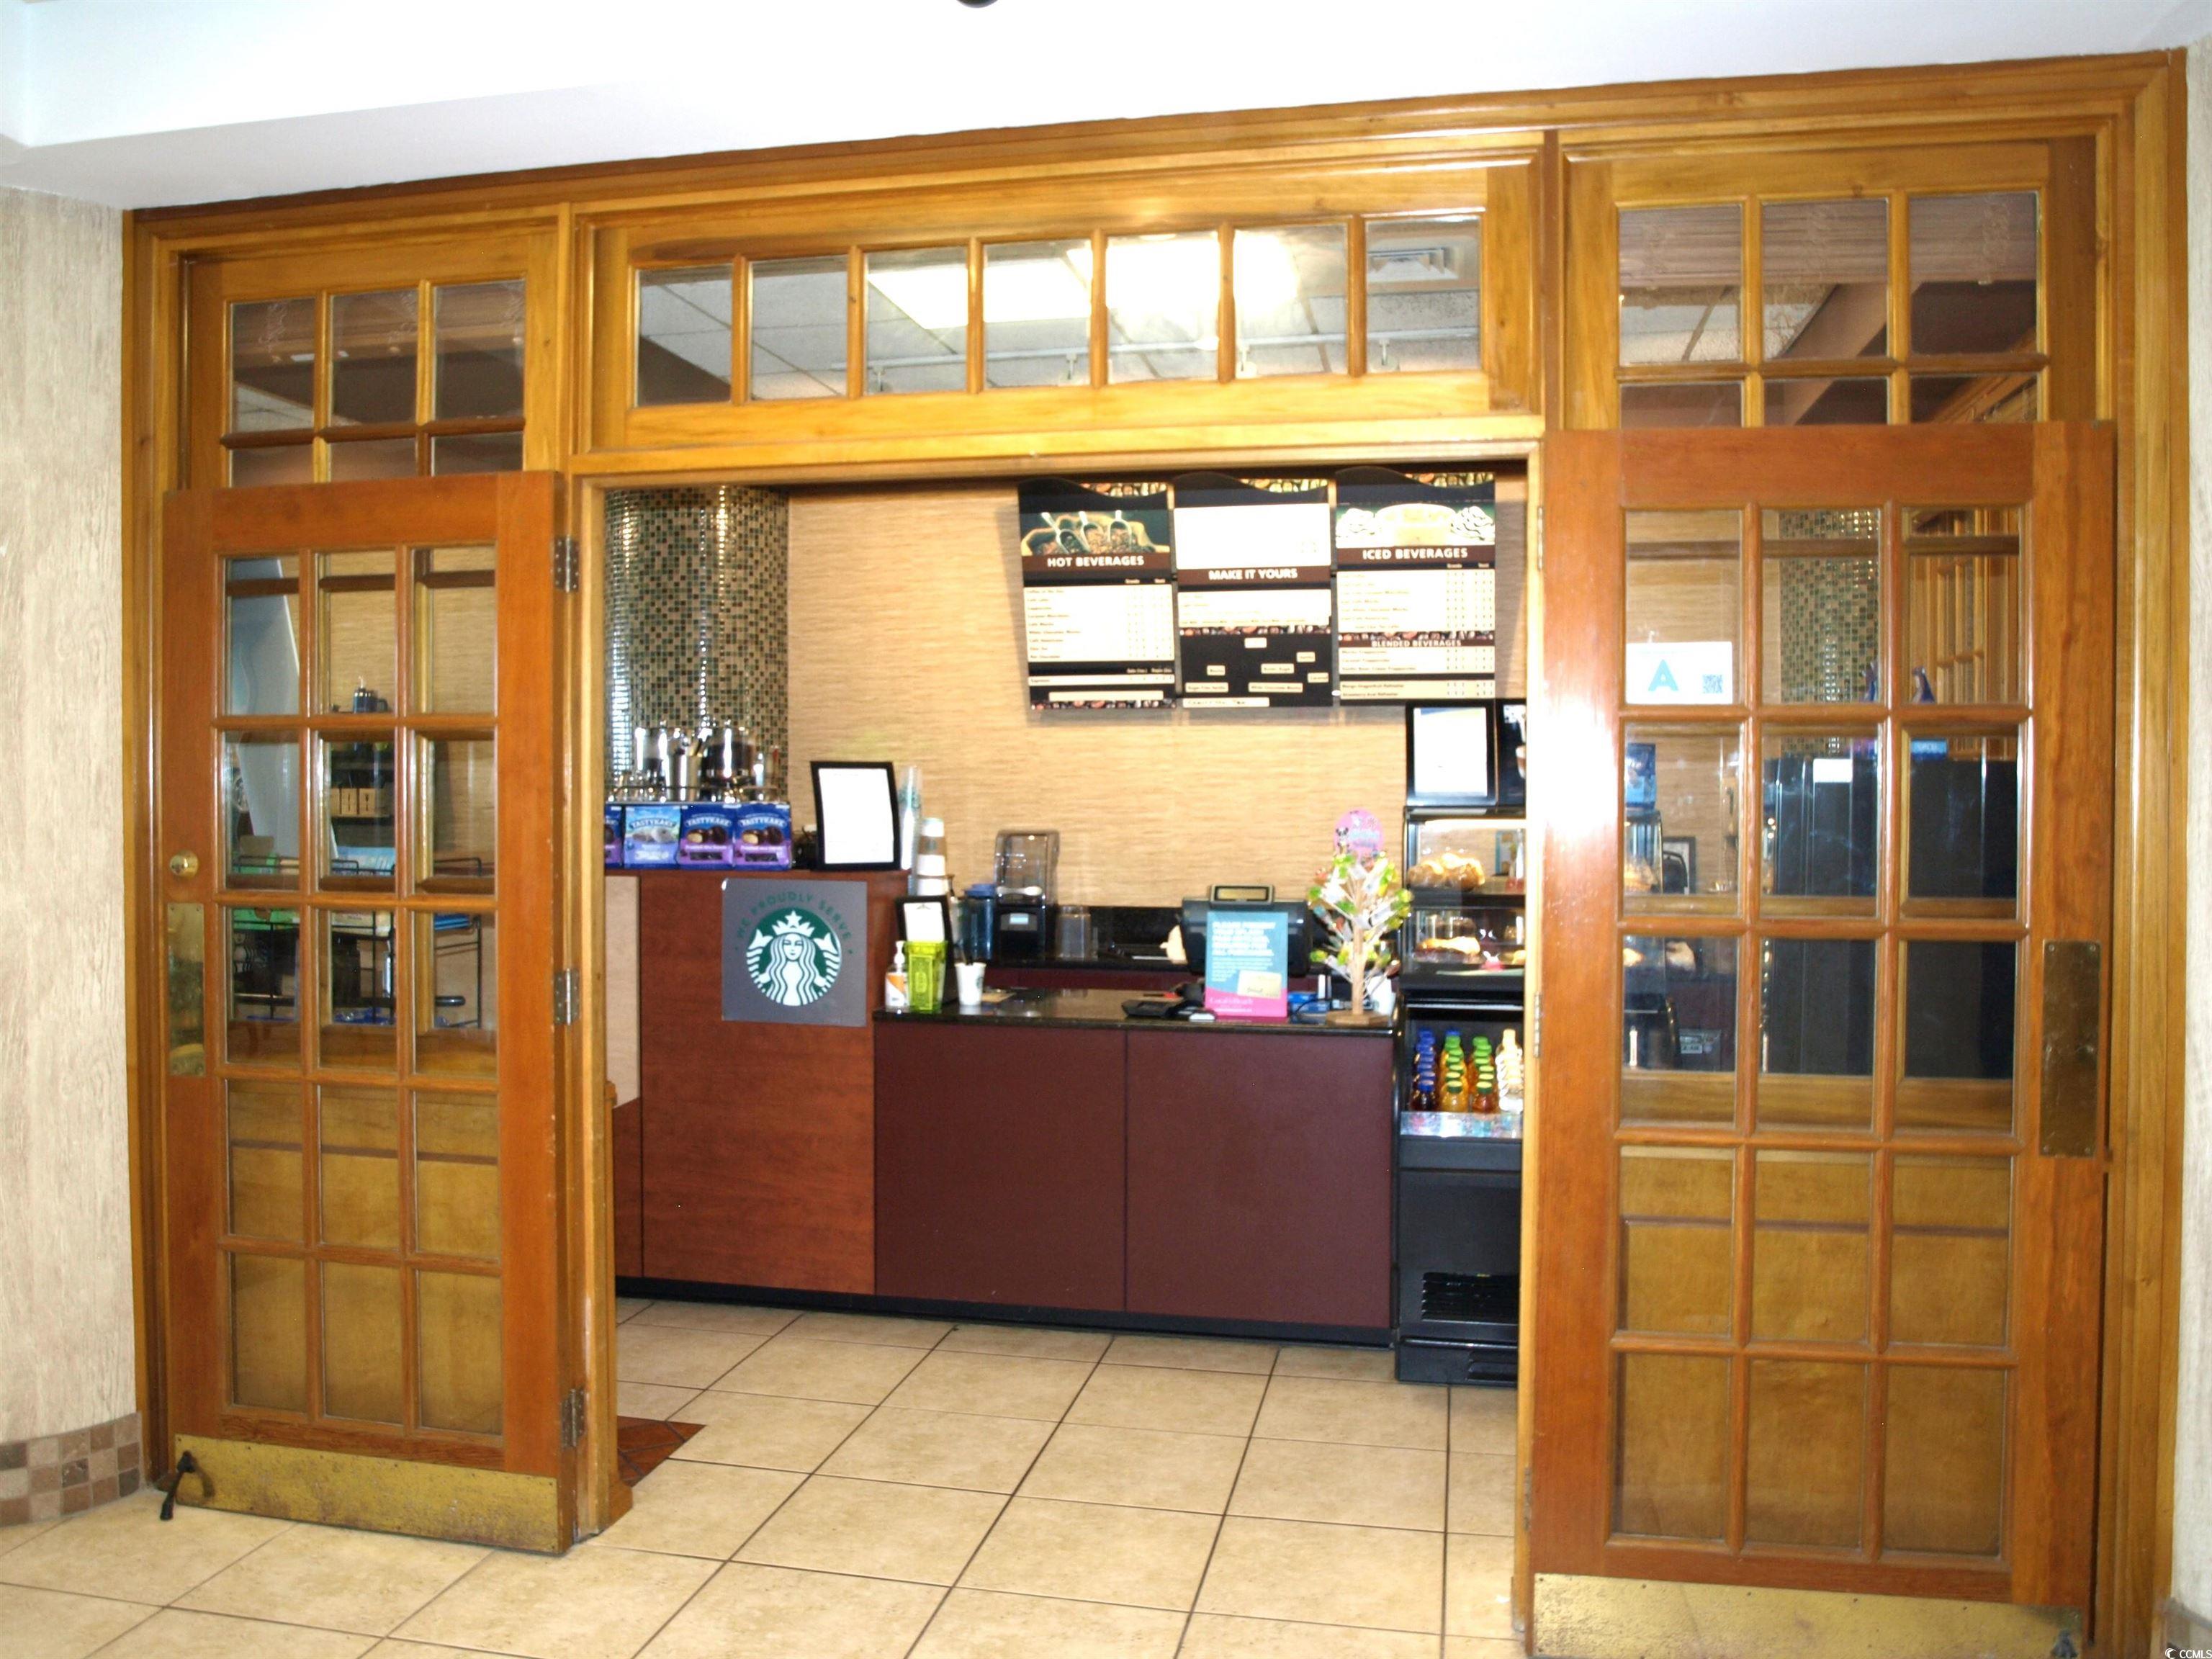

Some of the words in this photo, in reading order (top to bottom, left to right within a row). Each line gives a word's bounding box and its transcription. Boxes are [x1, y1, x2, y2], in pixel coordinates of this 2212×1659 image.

[1362, 549, 1392, 559] ICED
[1395, 548, 1468, 559] BEVERAGES
[1047, 557, 1073, 567] HOT
[1075, 555, 1145, 567] BEVERAGES
[1208, 570, 1243, 580] MAKE
[1245, 569, 1256, 580] IT
[1257, 568, 1298, 579] YOURS
[1647, 659, 1679, 692] A
[687, 817, 731, 827] TASTYKAKE
[739, 817, 786, 827] TASTYKAKE
[737, 917, 752, 939] WE
[750, 891, 814, 914] PROUDLY
[818, 900, 852, 940] SERVE
